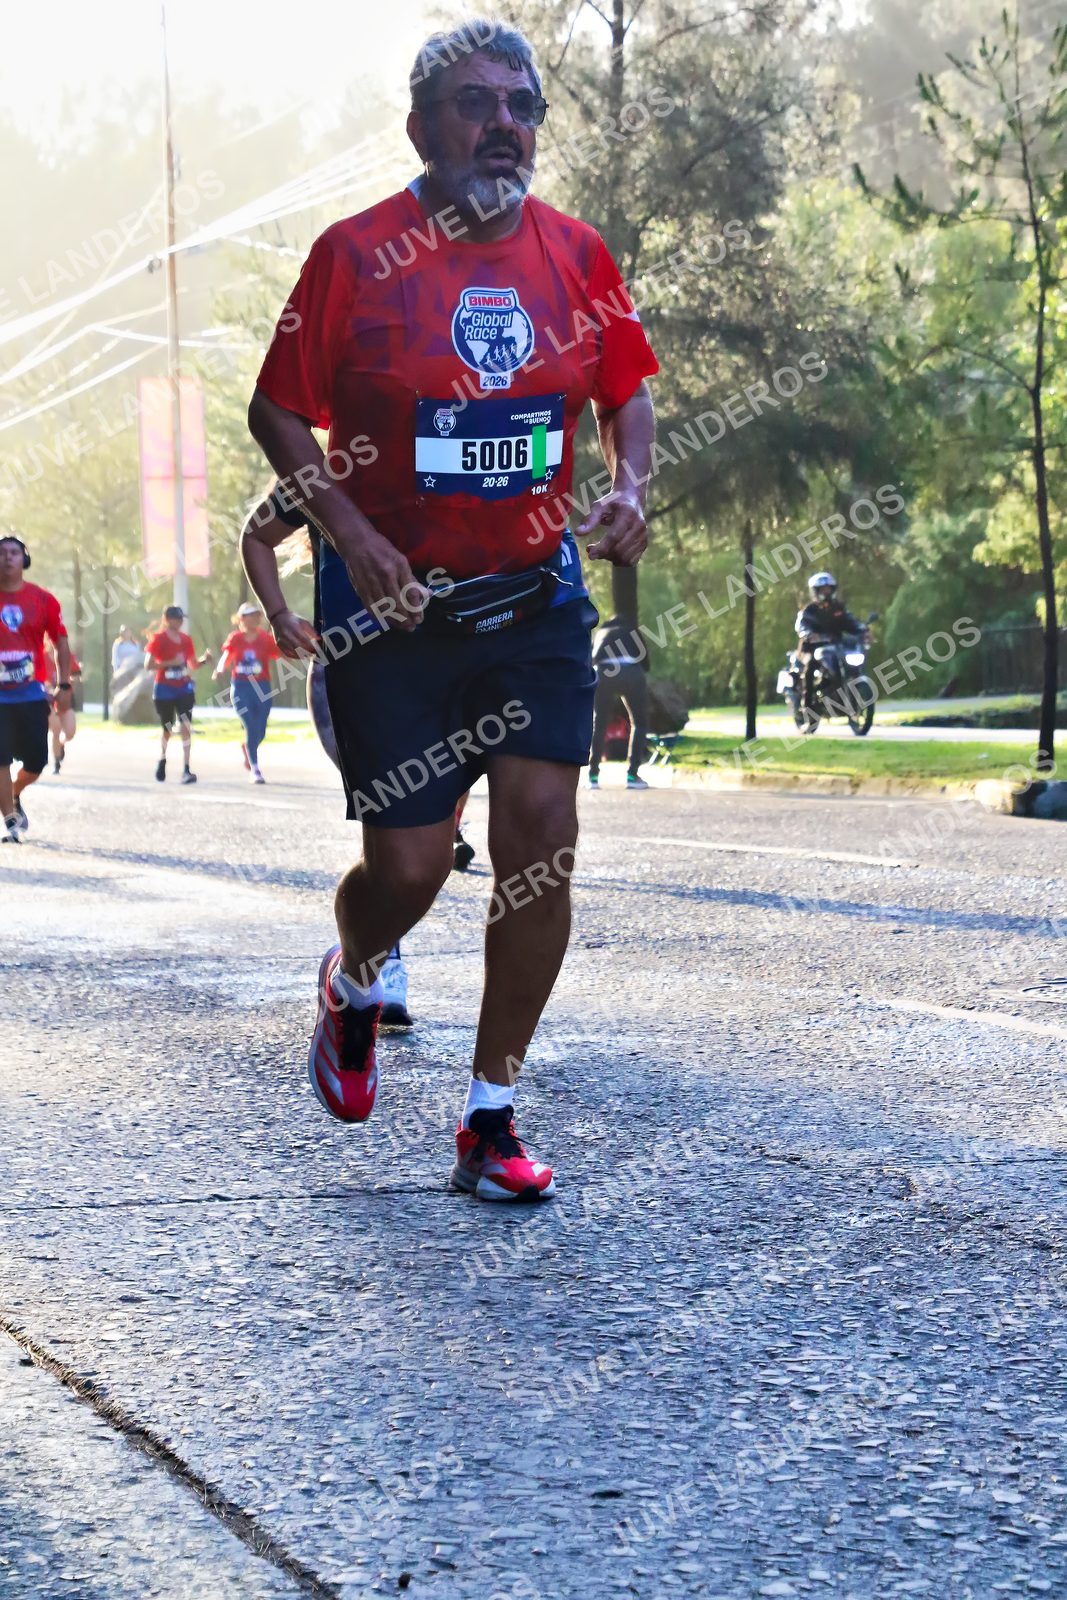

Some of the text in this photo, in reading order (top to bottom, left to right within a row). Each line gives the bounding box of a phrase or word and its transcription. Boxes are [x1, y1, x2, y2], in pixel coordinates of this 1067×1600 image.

[468, 296, 512, 307] BIMBO
[471, 312, 513, 328] Global
[464, 325, 498, 340] Race
[482, 375, 508, 387] 2026
[510, 410, 552, 421] COMPARTIMOS
[529, 415, 552, 425] BUENO
[461, 438, 528, 471] 5006
[531, 484, 548, 495] 10K
[475, 610, 513, 629] CARRERA
